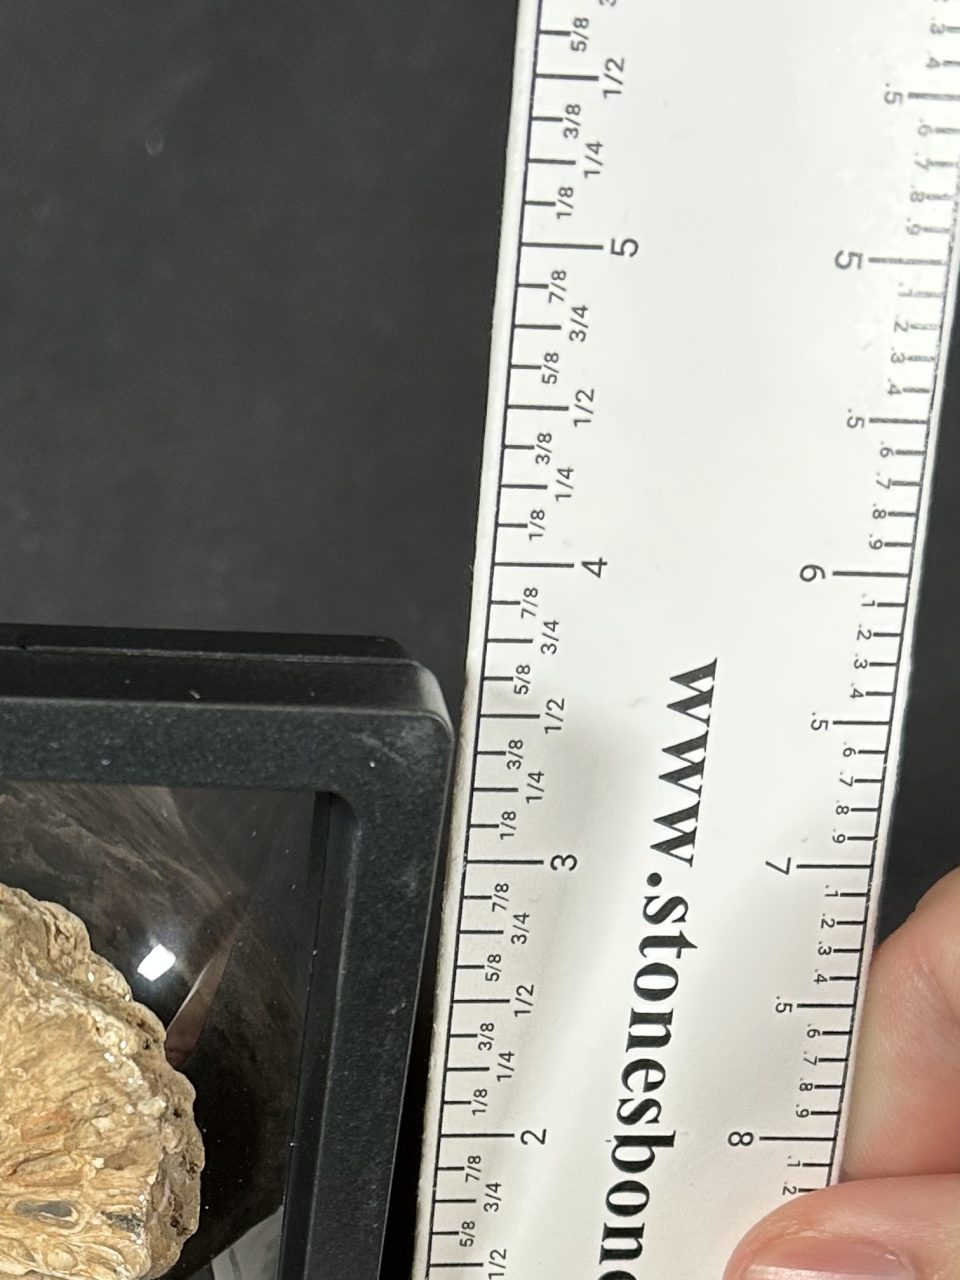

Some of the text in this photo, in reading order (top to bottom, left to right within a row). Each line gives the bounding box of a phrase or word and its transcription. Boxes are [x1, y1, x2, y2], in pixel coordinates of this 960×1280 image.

[568, 17, 589, 52] 5/8
[603, 58, 624, 99] 1/2
[563, 104, 581, 139] 3/8
[584, 142, 603, 178] 1/4
[556, 187, 573, 219] 1/8
[610, 238, 639, 257] 5
[835, 250, 863, 270] 5
[548, 270, 566, 303] 7/8
[569, 305, 588, 342] 3/4
[542, 352, 559, 384] 5/8
[573, 389, 594, 427] 1/2
[535, 433, 552, 464] 3/8
[555, 467, 574, 502] 1/4
[529, 509, 545, 541] 1/8
[581, 558, 607, 578] 4
[800, 564, 825, 582] 6
[521, 588, 538, 619] 7/8
[541, 620, 559, 654] 3/4
[513, 665, 530, 695] 5/8
[544, 698, 564, 734] 1/2
[507, 740, 523, 770] 3/8
[526, 771, 544, 804] 1/4
[500, 811, 516, 840] 1/8
[550, 855, 577, 871] 3
[766, 857, 791, 875] 7
[492, 883, 509, 912] 7/8
[511, 913, 530, 944] 3/4
[485, 954, 501, 981] 5/8
[514, 985, 534, 1017] 1/2
[478, 1023, 494, 1051] 3/8
[497, 1051, 515, 1082] 1/4
[472, 1089, 488, 1115] 1/8
[520, 1129, 546, 1145] 2
[728, 1132, 754, 1146] 8
[465, 1156, 481, 1183] 7/8
[483, 1182, 502, 1212] 3/4
[459, 1221, 475, 1247] 5/8
[488, 1249, 506, 1280] 1/2
